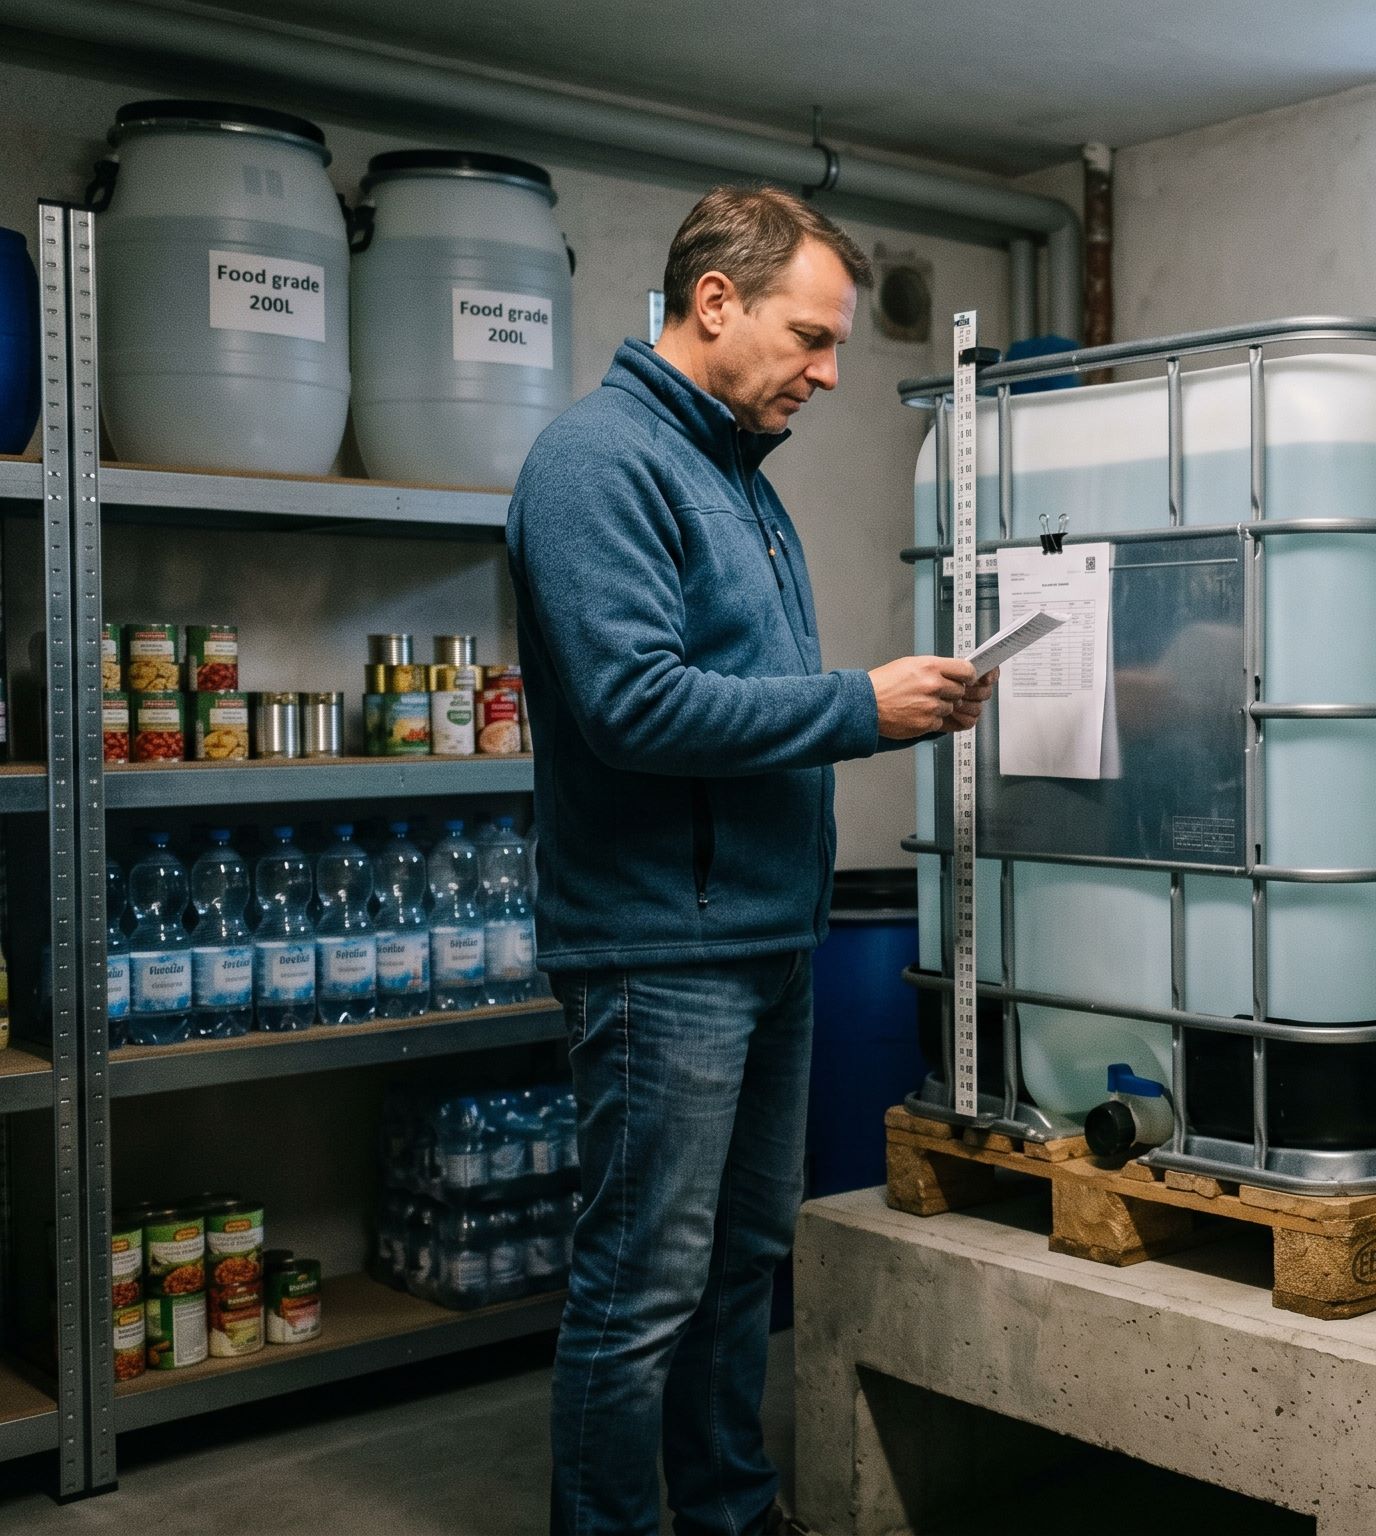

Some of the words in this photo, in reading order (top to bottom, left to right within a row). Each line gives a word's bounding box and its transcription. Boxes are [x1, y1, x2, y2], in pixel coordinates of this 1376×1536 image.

[217, 264, 266, 285] Food
[273, 274, 320, 293] grade
[249, 294, 294, 315] 200L
[460, 301, 503, 318] Food
[508, 308, 549, 325] grade
[488, 328, 527, 345] 200L
